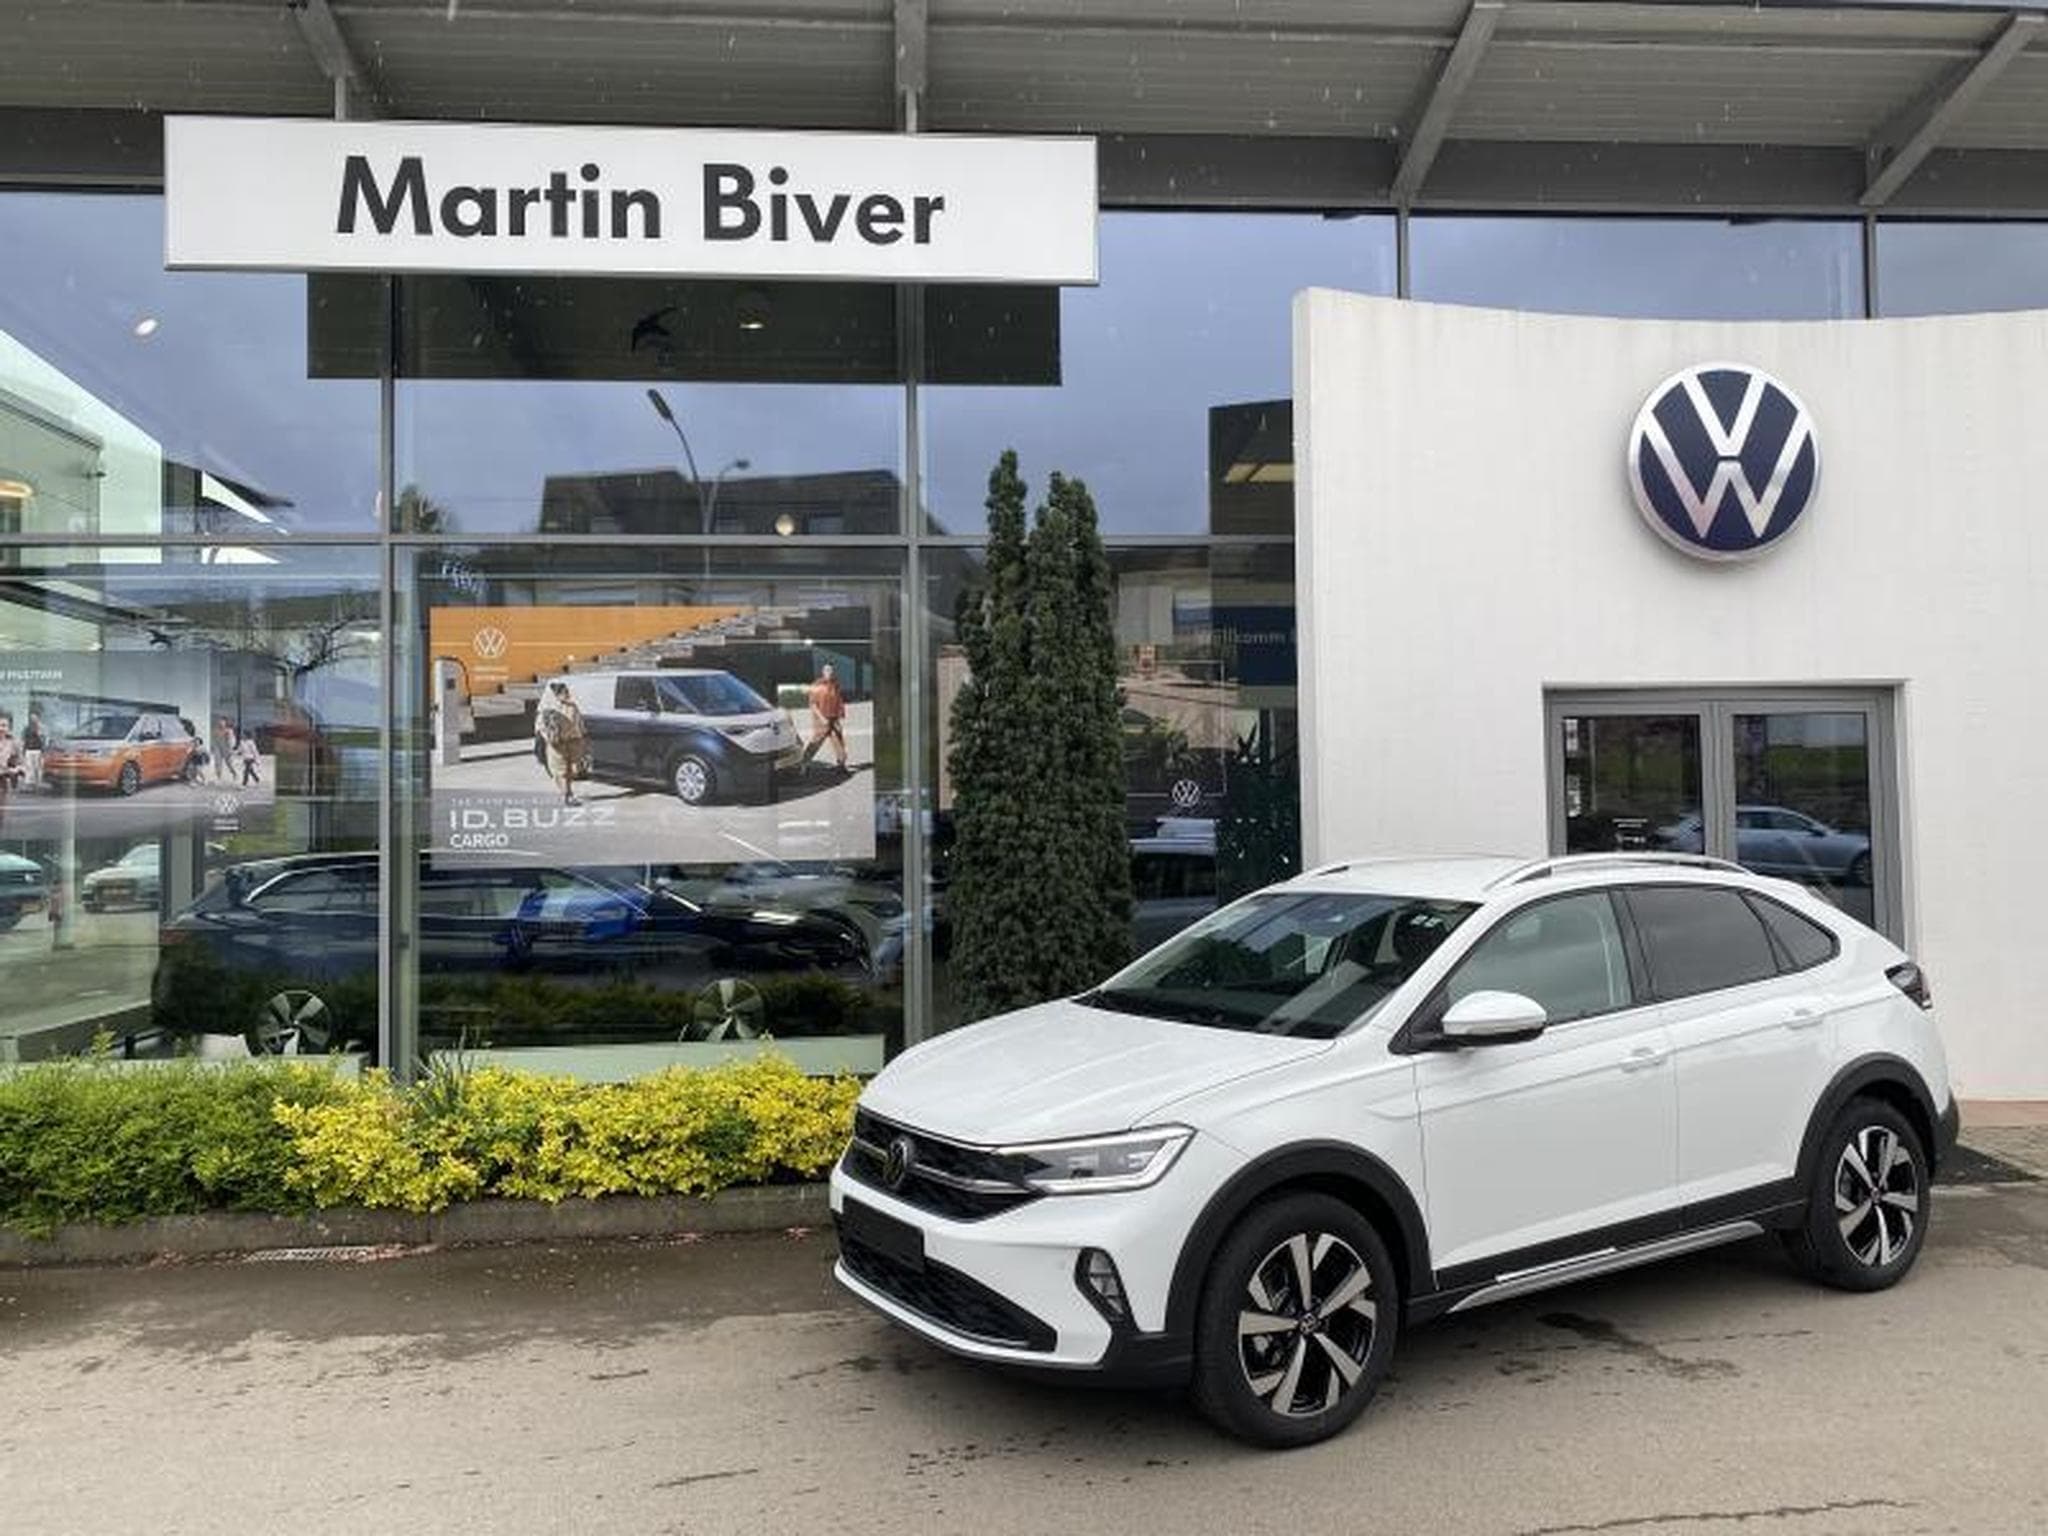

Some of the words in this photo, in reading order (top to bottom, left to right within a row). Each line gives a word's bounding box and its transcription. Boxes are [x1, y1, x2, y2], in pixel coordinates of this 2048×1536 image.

[336, 155, 663, 239] Martin
[702, 162, 945, 244] Biver
[1632, 364, 1818, 552] VW
[450, 809, 498, 829] ID.
[503, 807, 616, 829] BUZZ
[450, 833, 510, 848] CARGO
